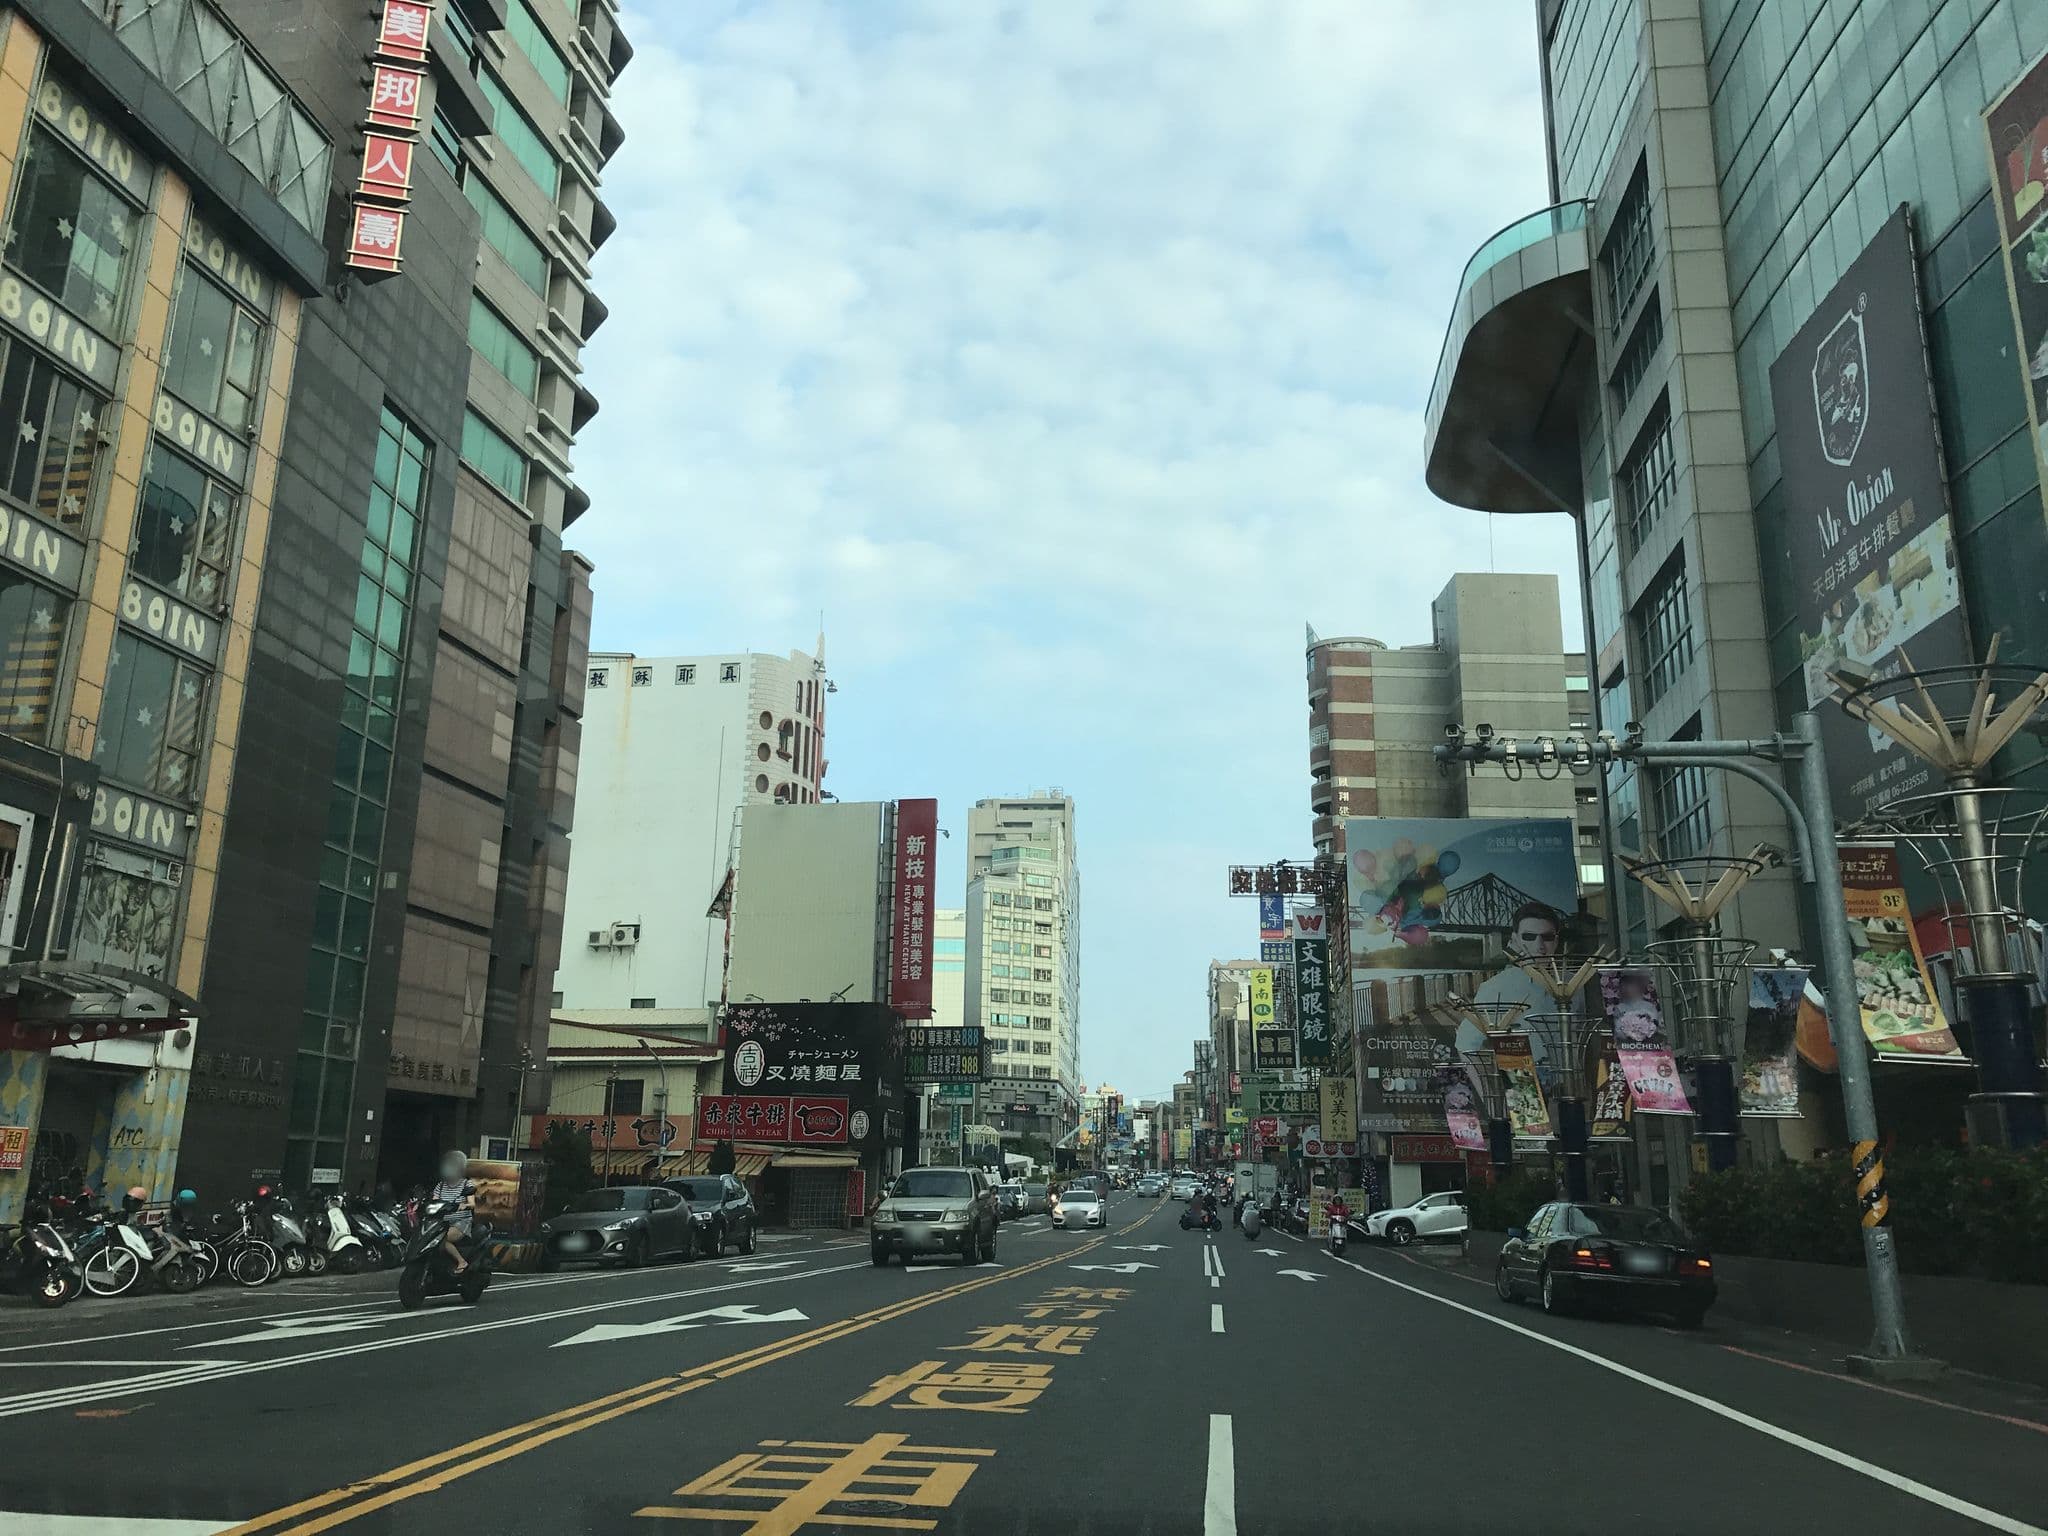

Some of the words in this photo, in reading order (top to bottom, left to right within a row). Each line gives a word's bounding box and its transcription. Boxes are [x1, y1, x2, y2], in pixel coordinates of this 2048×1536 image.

[40, 79, 135, 184] BOIN
[357, 5, 425, 249] 美邦人壽
[188, 217, 261, 302] BOIN
[0, 277, 98, 373] BOIN
[155, 394, 233, 473] BOIN
[1847, 466, 1894, 527] Onion
[122, 583, 206, 652] BOIN
[905, 835, 926, 879] 新技
[1883, 895, 1901, 907] 3F
[903, 922, 911, 946] HAIR
[909, 884, 925, 980] 專業髮型美容
[901, 946, 909, 980] CENTER
[1300, 941, 1328, 1041] 文雄眼鏡
[787, 1050, 859, 1060] チャーシューメン
[910, 1029, 925, 1046] 99
[961, 1029, 979, 1046] 888
[1366, 1037, 1437, 1050] Chromea7
[766, 1064, 862, 1082] 叉燒麵屋
[961, 1056, 978, 1074] 988
